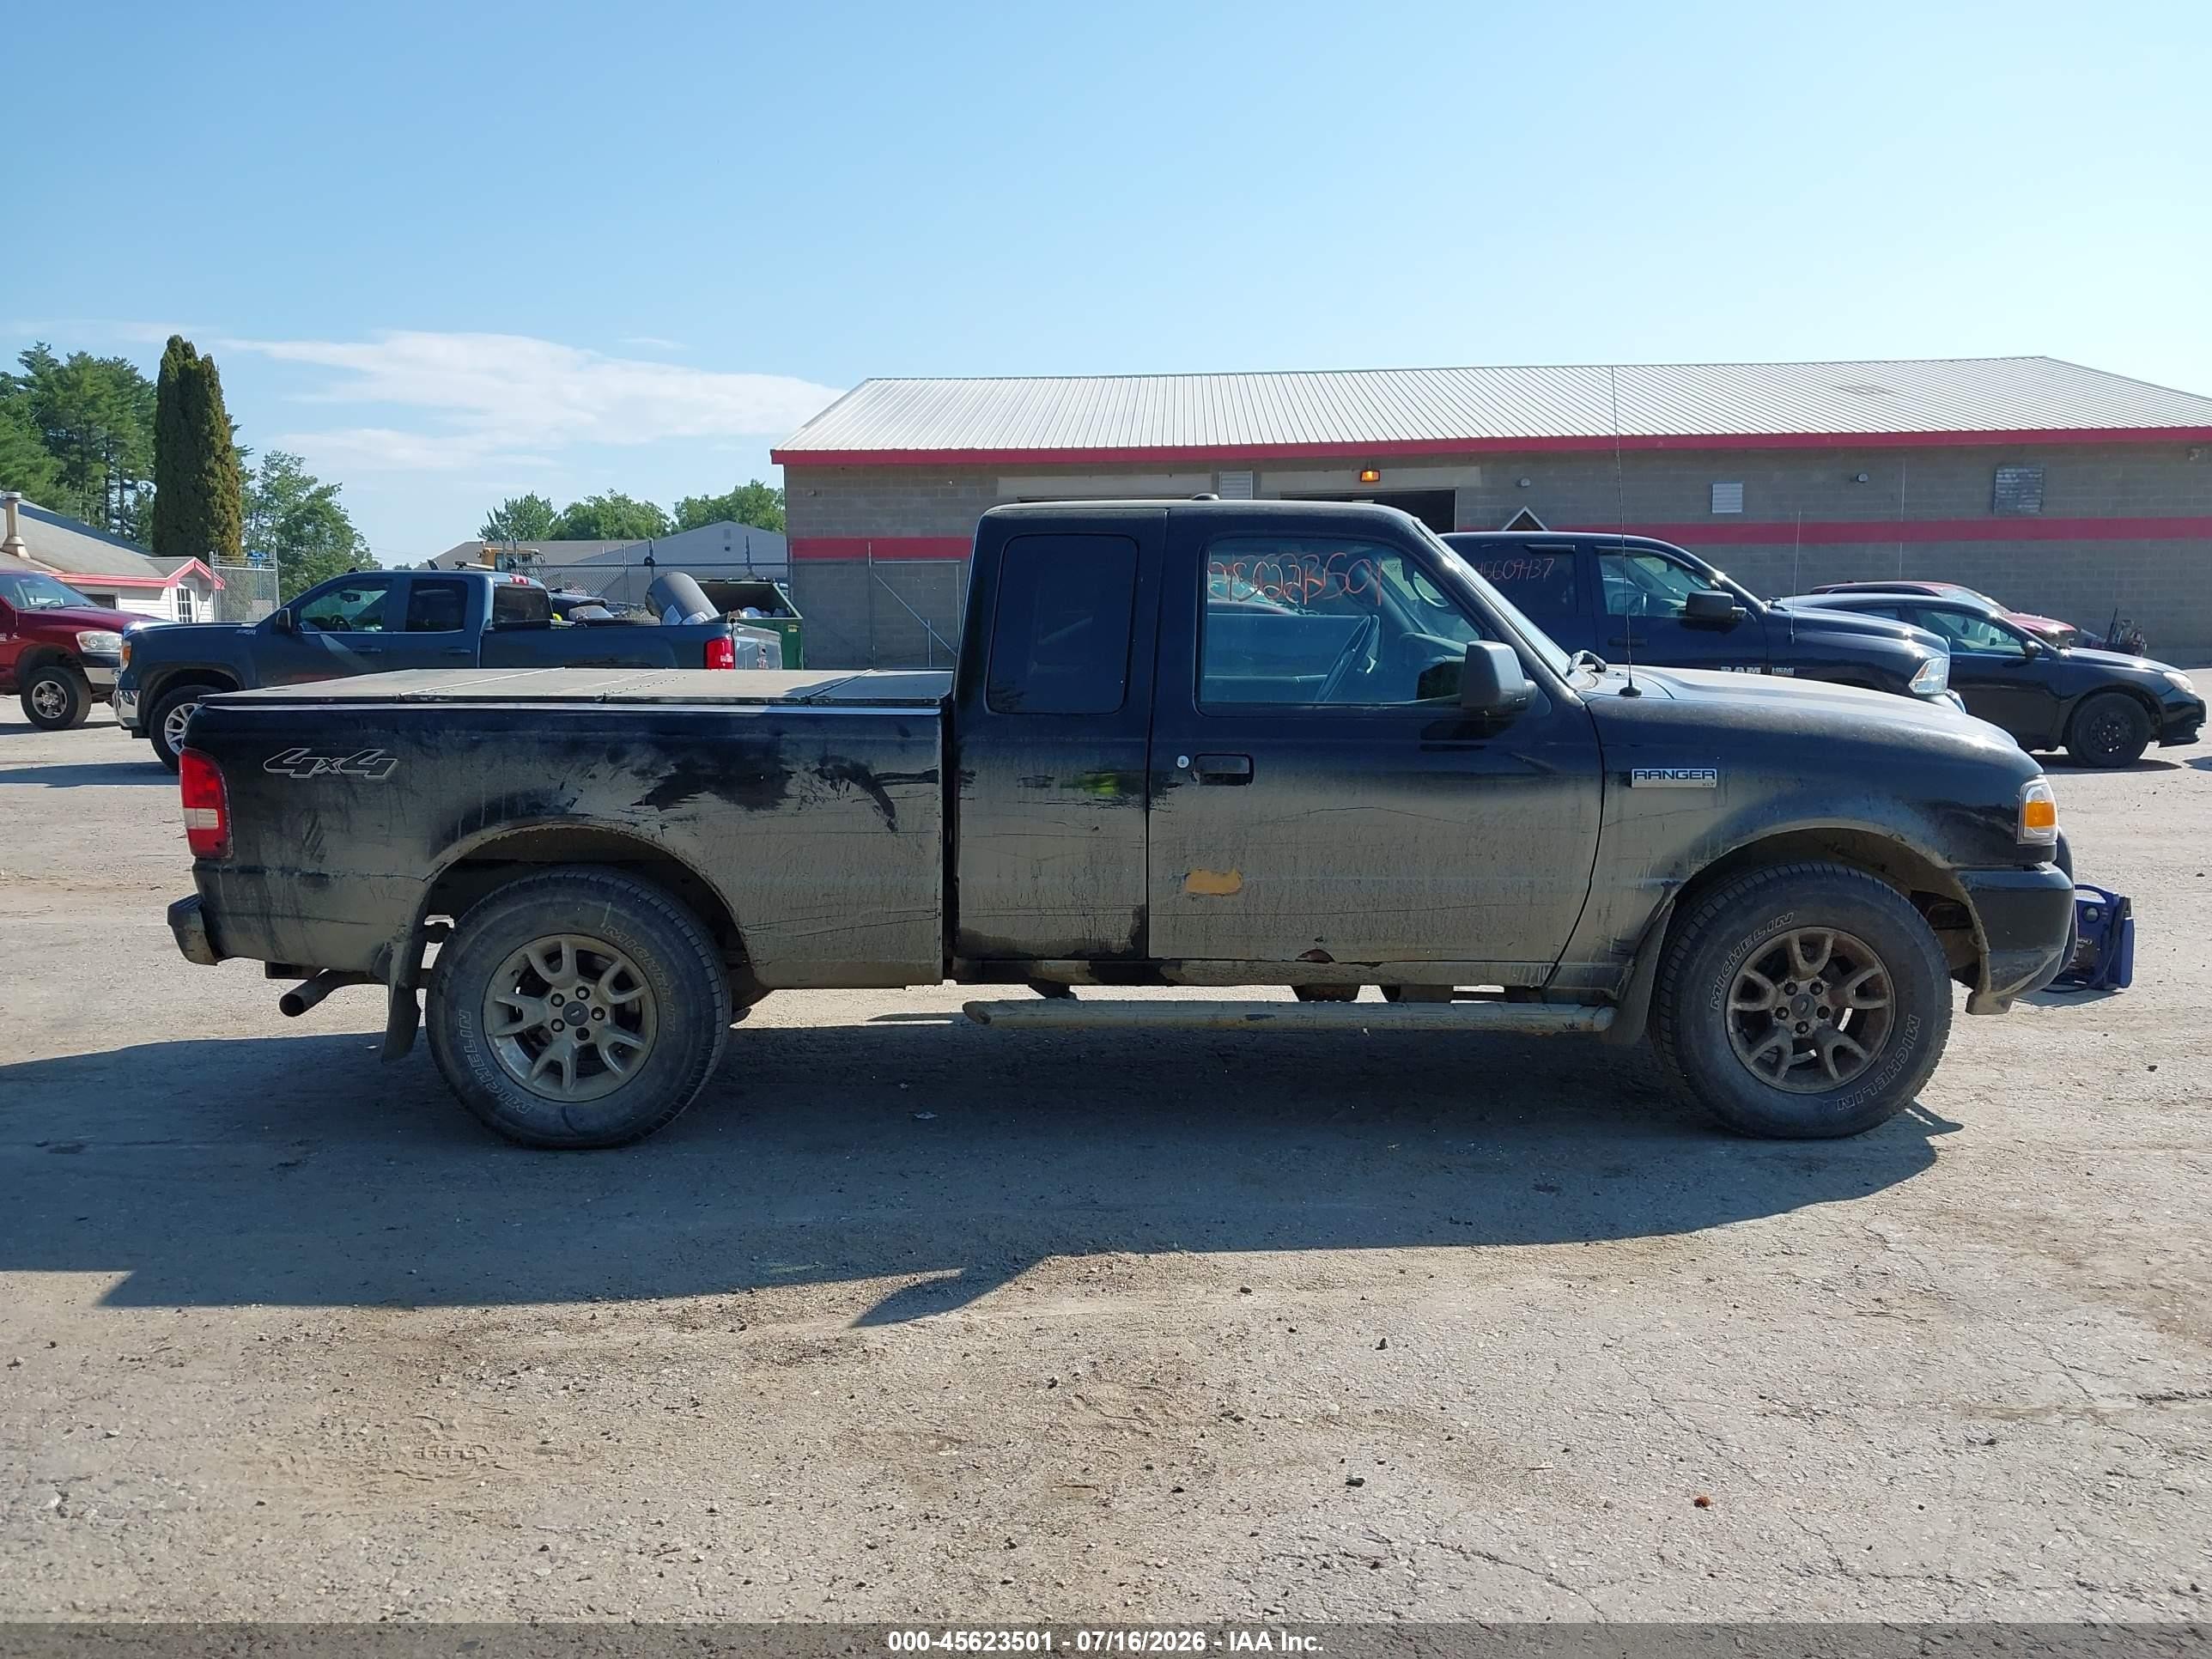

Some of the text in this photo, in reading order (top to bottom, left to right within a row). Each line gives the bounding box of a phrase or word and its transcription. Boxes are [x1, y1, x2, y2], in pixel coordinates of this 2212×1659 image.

[263, 748, 398, 779] 4x4
[1633, 769, 1716, 781] RANGER
[603, 925, 676, 1031] MICHELIN
[1710, 912, 1794, 1011] MICHELIN
[459, 1009, 533, 1114] MICHELIN
[1836, 1014, 1921, 1110] MICHELIN
